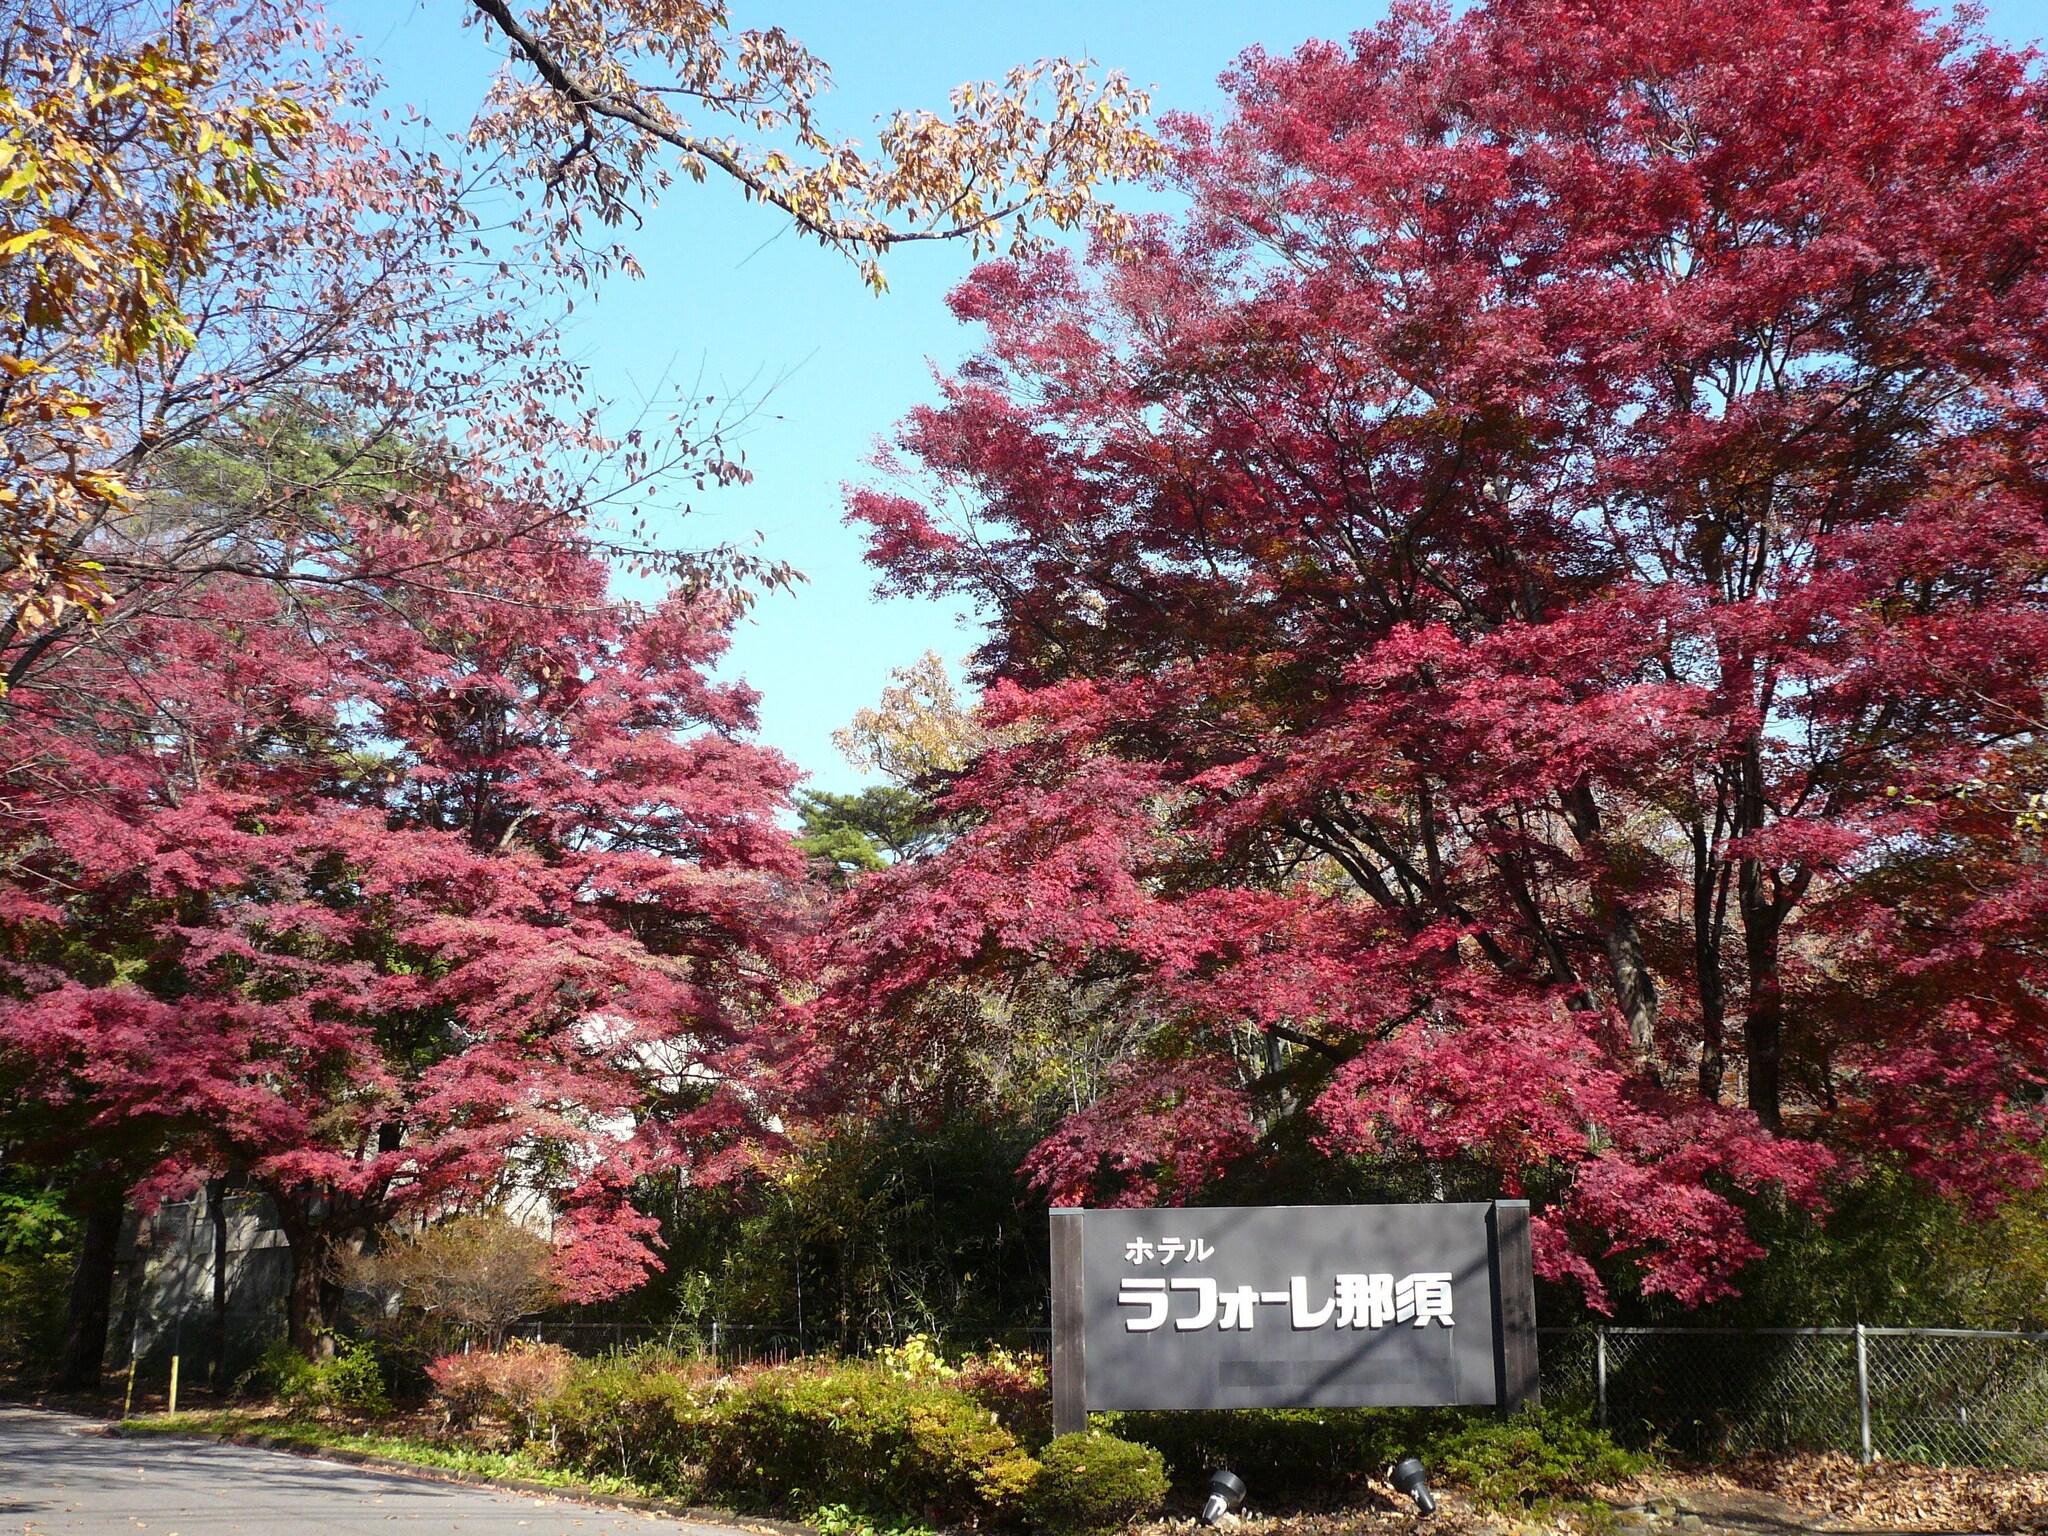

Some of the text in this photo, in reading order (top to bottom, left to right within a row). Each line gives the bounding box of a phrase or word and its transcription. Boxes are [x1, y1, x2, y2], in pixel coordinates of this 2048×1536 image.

[1124, 1236, 1215, 1266] ホテル
[1118, 1272, 1456, 1331] ラフォーレ那須
